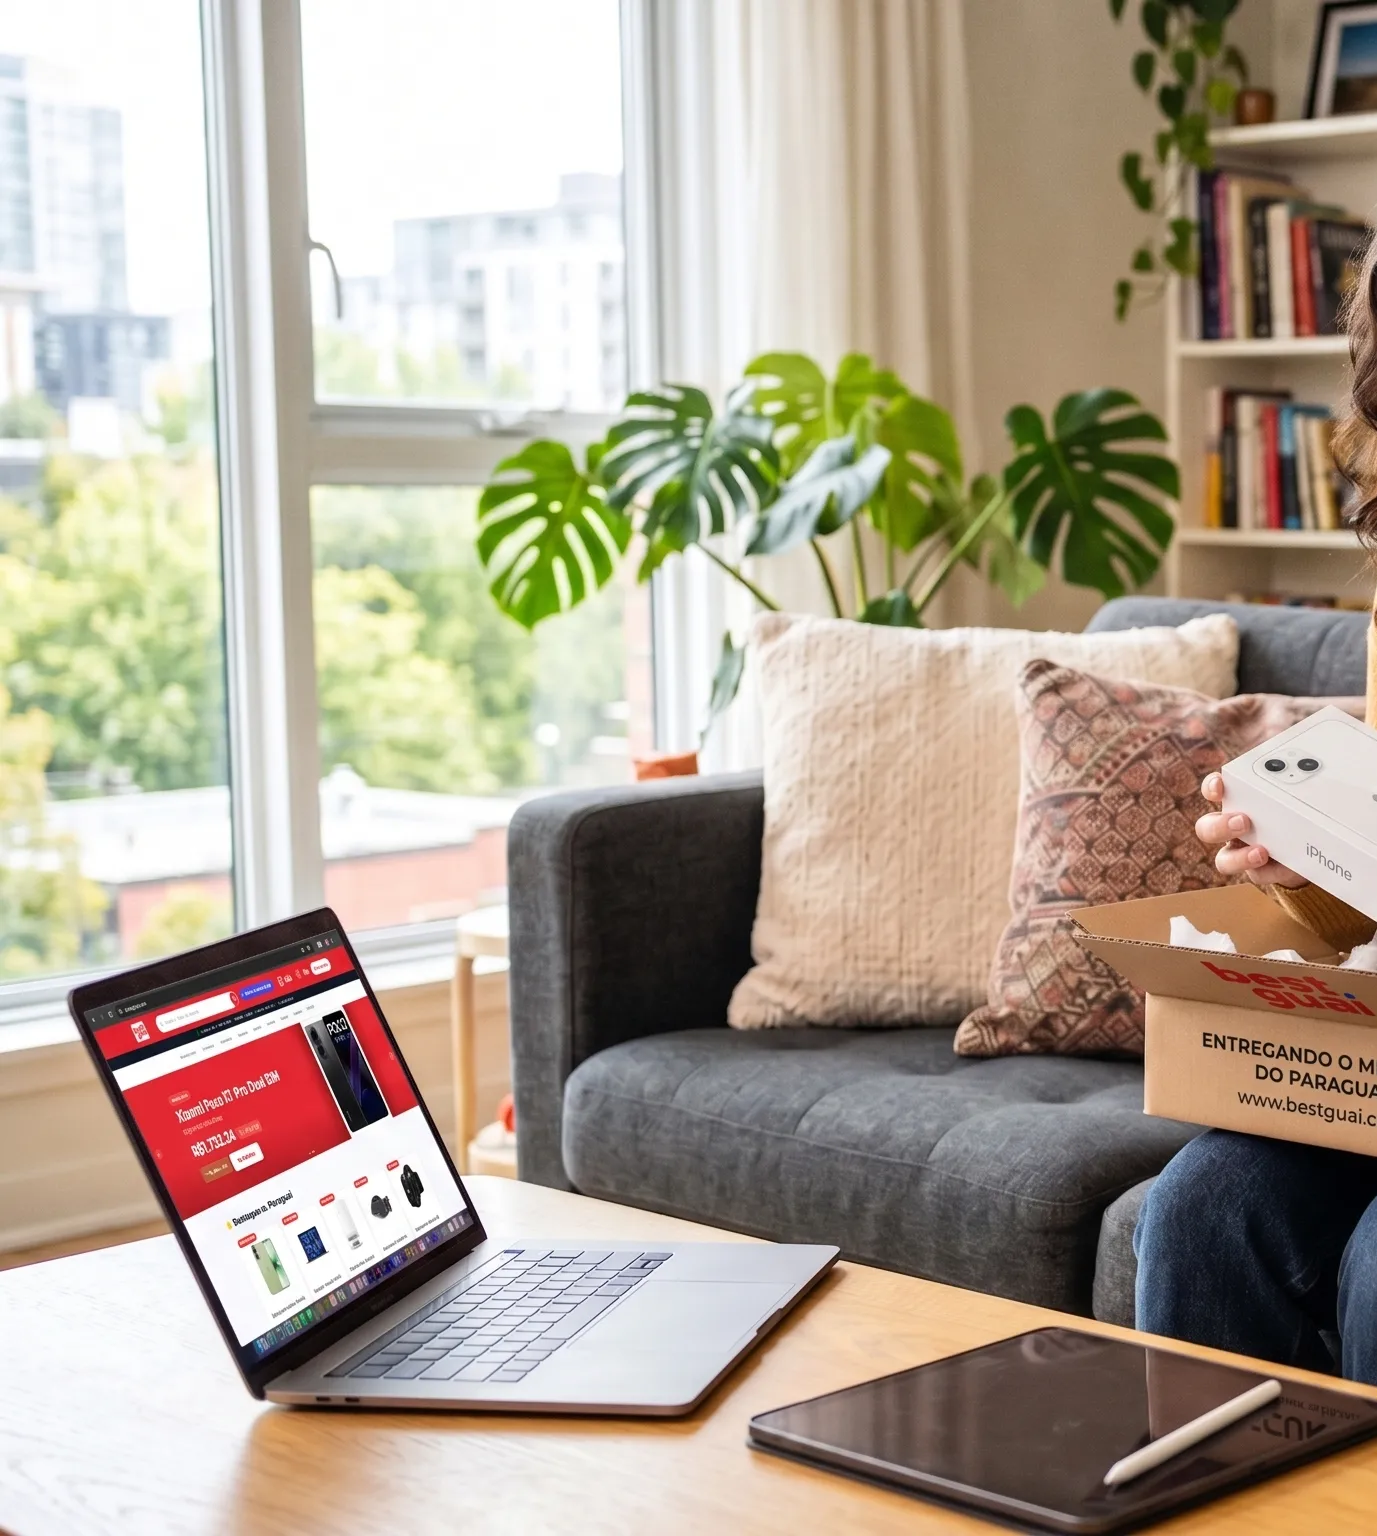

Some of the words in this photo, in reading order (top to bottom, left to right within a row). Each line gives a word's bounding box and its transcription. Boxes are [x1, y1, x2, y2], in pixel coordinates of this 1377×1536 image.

[1306, 842, 1352, 881] iPhone
[1200, 961, 1340, 996] best
[1252, 987, 1376, 1016] guai
[1202, 1032, 1333, 1068] ENTREGANDO
[1338, 1054, 1353, 1071] O
[1255, 1064, 1284, 1083] DO
